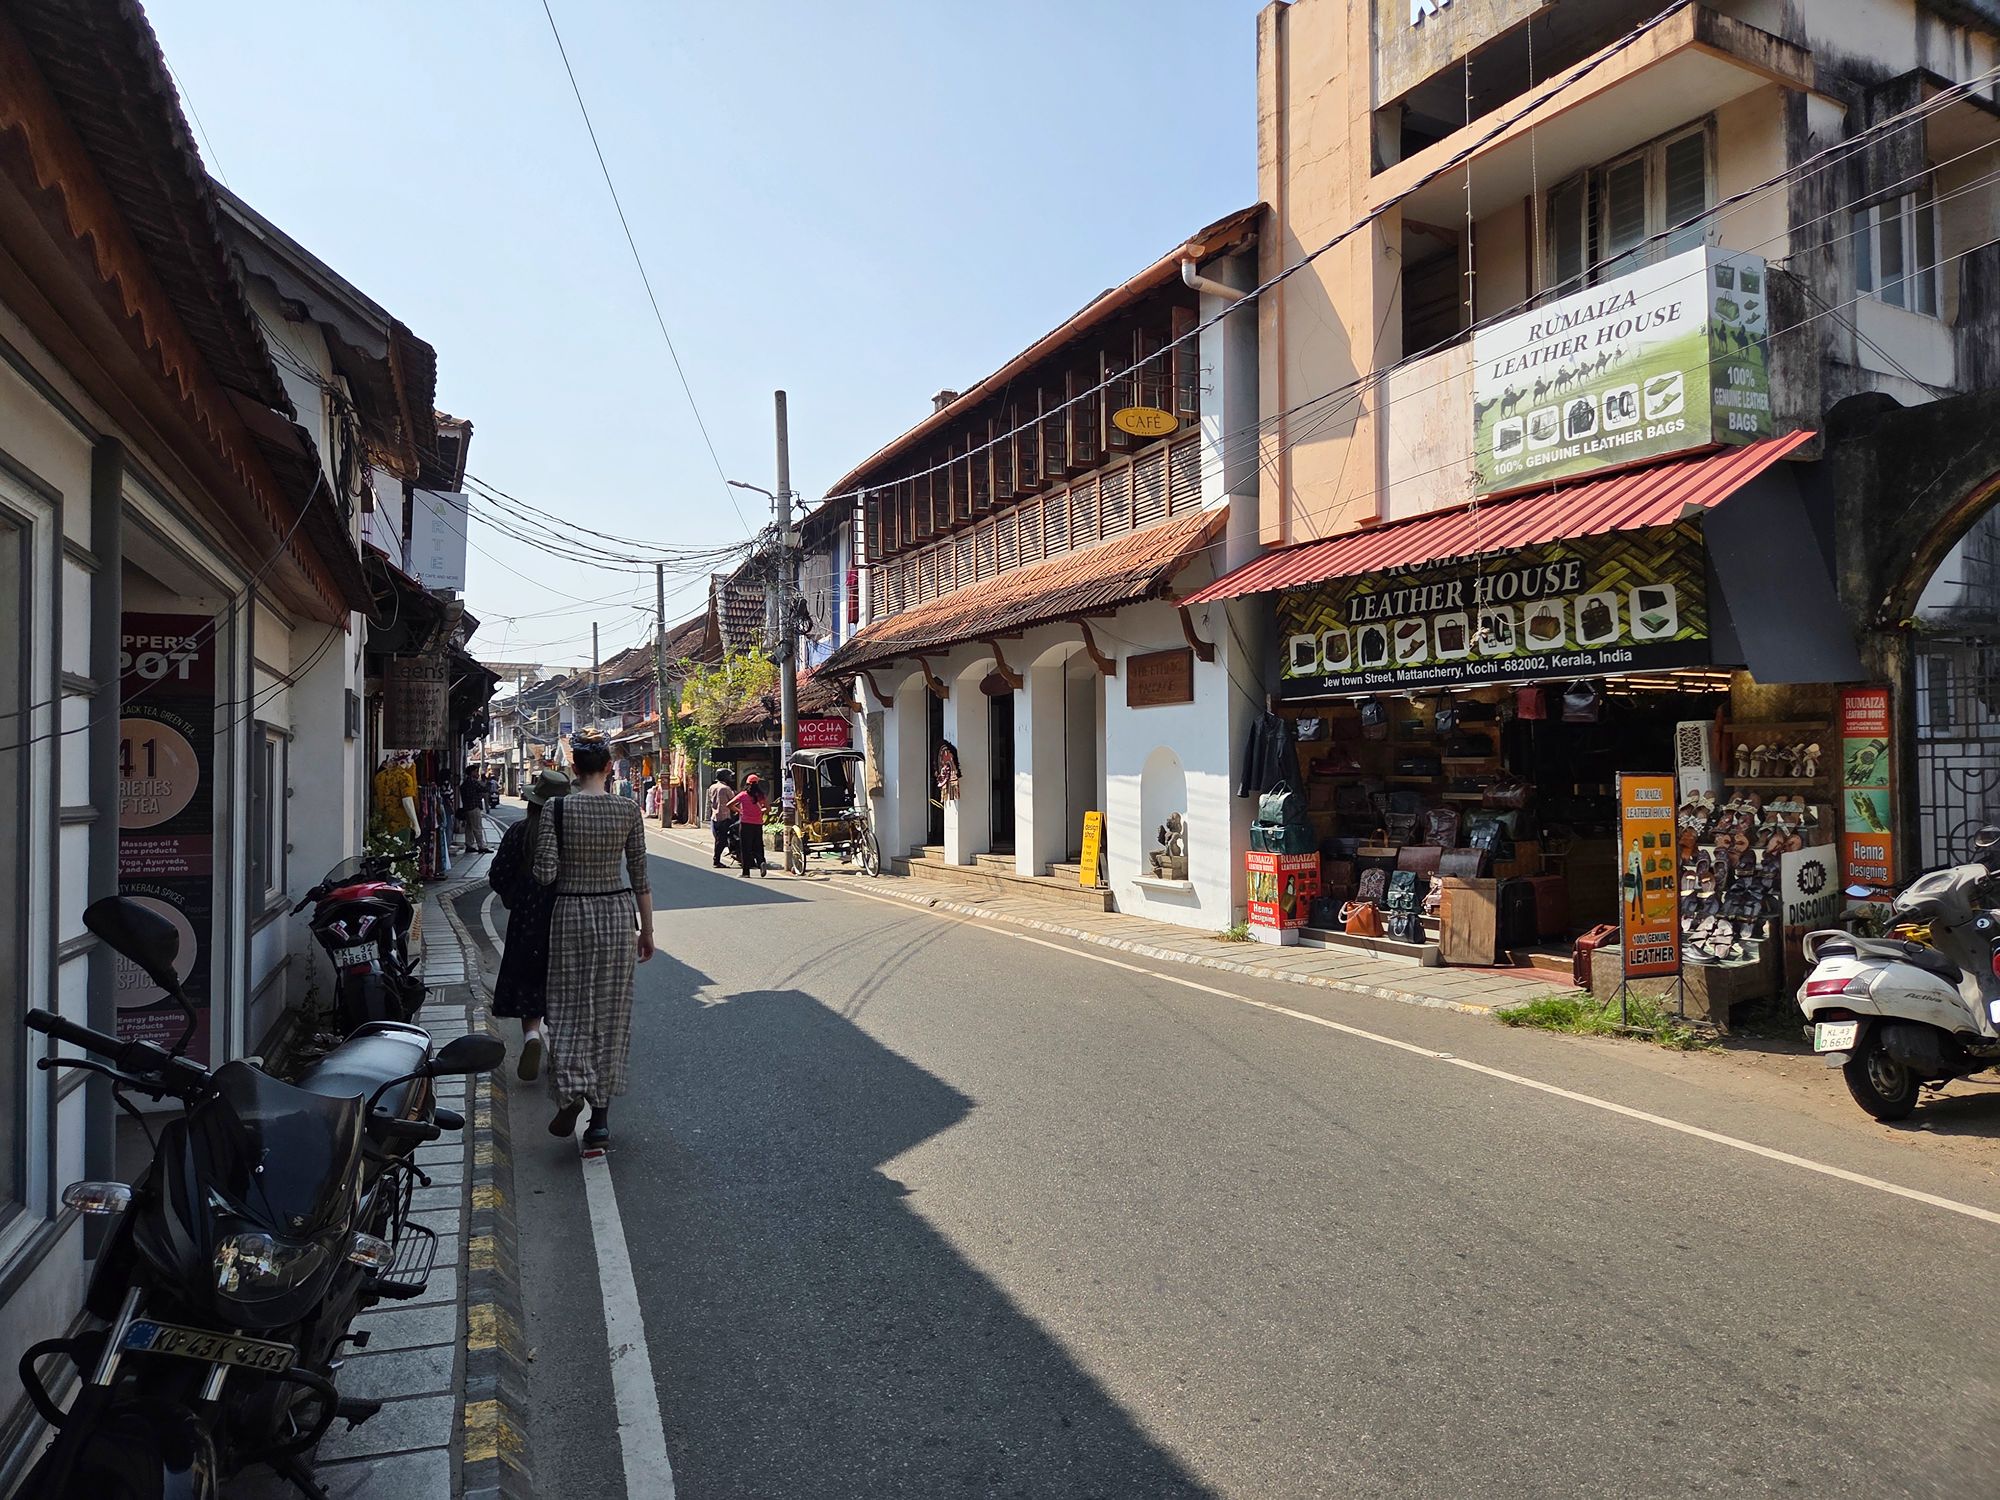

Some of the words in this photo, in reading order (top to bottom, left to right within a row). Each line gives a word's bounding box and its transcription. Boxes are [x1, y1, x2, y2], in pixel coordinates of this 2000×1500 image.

[1528, 290, 1638, 342] RUMAIZA
[1491, 334, 1588, 380] LEATHER
[1595, 301, 1683, 348] HOUSE
[1727, 366, 1755, 388] 100%
[1714, 387, 1742, 408] GENUINE
[1742, 389, 1770, 410] LEATHER
[1728, 413, 1758, 433] BAGS
[1493, 459, 1524, 477] 100%
[1526, 444, 1581, 469] GENUINE
[1583, 431, 1644, 455] LEATHER
[1646, 418, 1686, 440] BAGS
[1350, 583, 1465, 623] LEATHER
[1474, 560, 1582, 605] HOUSE
[1323, 673, 1341, 688] Jew
[1342, 674, 1363, 687] town
[1365, 671, 1396, 687] Street,
[1396, 664, 1464, 683] Mattancherry,
[1466, 660, 1499, 677] Kochi
[1501, 656, 1550, 675] -682002,
[1551, 651, 1598, 671] Kerala,
[1599, 649, 1633, 665] India
[1845, 697, 1886, 710] RUMAIZA
[1846, 710, 1867, 720] LEATHER
[1868, 709, 1886, 719] HOUSE
[798, 722, 843, 733] MOCHA
[818, 734, 839, 742] CAFE
[1635, 789, 1663, 801] RUMAIZA
[133, 798, 160, 814] TEA
[1626, 807, 1652, 819] LEATHER
[1652, 806, 1672, 818] HOUSE
[121, 840, 158, 849] Massage
[160, 839, 171, 847] oil
[119, 847, 139, 855] care
[140, 847, 177, 856] products
[1853, 841, 1884, 861] Henna
[121, 858, 144, 867] Yoga,
[145, 858, 188, 867] Ayurveda,
[1248, 854, 1275, 865] RUMAIZA
[1281, 853, 1316, 864] RUMAIZA
[143, 866, 166, 874] many
[1281, 863, 1301, 872] LEATHER
[1301, 861, 1317, 870] HOUSE
[1850, 862, 1888, 882] Designing
[1802, 868, 1822, 890] 50%
[131, 883, 161, 895] KERALA
[1253, 903, 1274, 915] Henna
[1788, 893, 1839, 926] DISCOUNT
[1251, 912, 1276, 925] Designing
[1647, 932, 1671, 944] GENUINE
[342, 948, 354, 957] KL
[360, 943, 373, 954] 32
[1629, 946, 1675, 965] LEATHER
[148, 1013, 185, 1023] Boosting
[126, 1022, 164, 1031] Products
